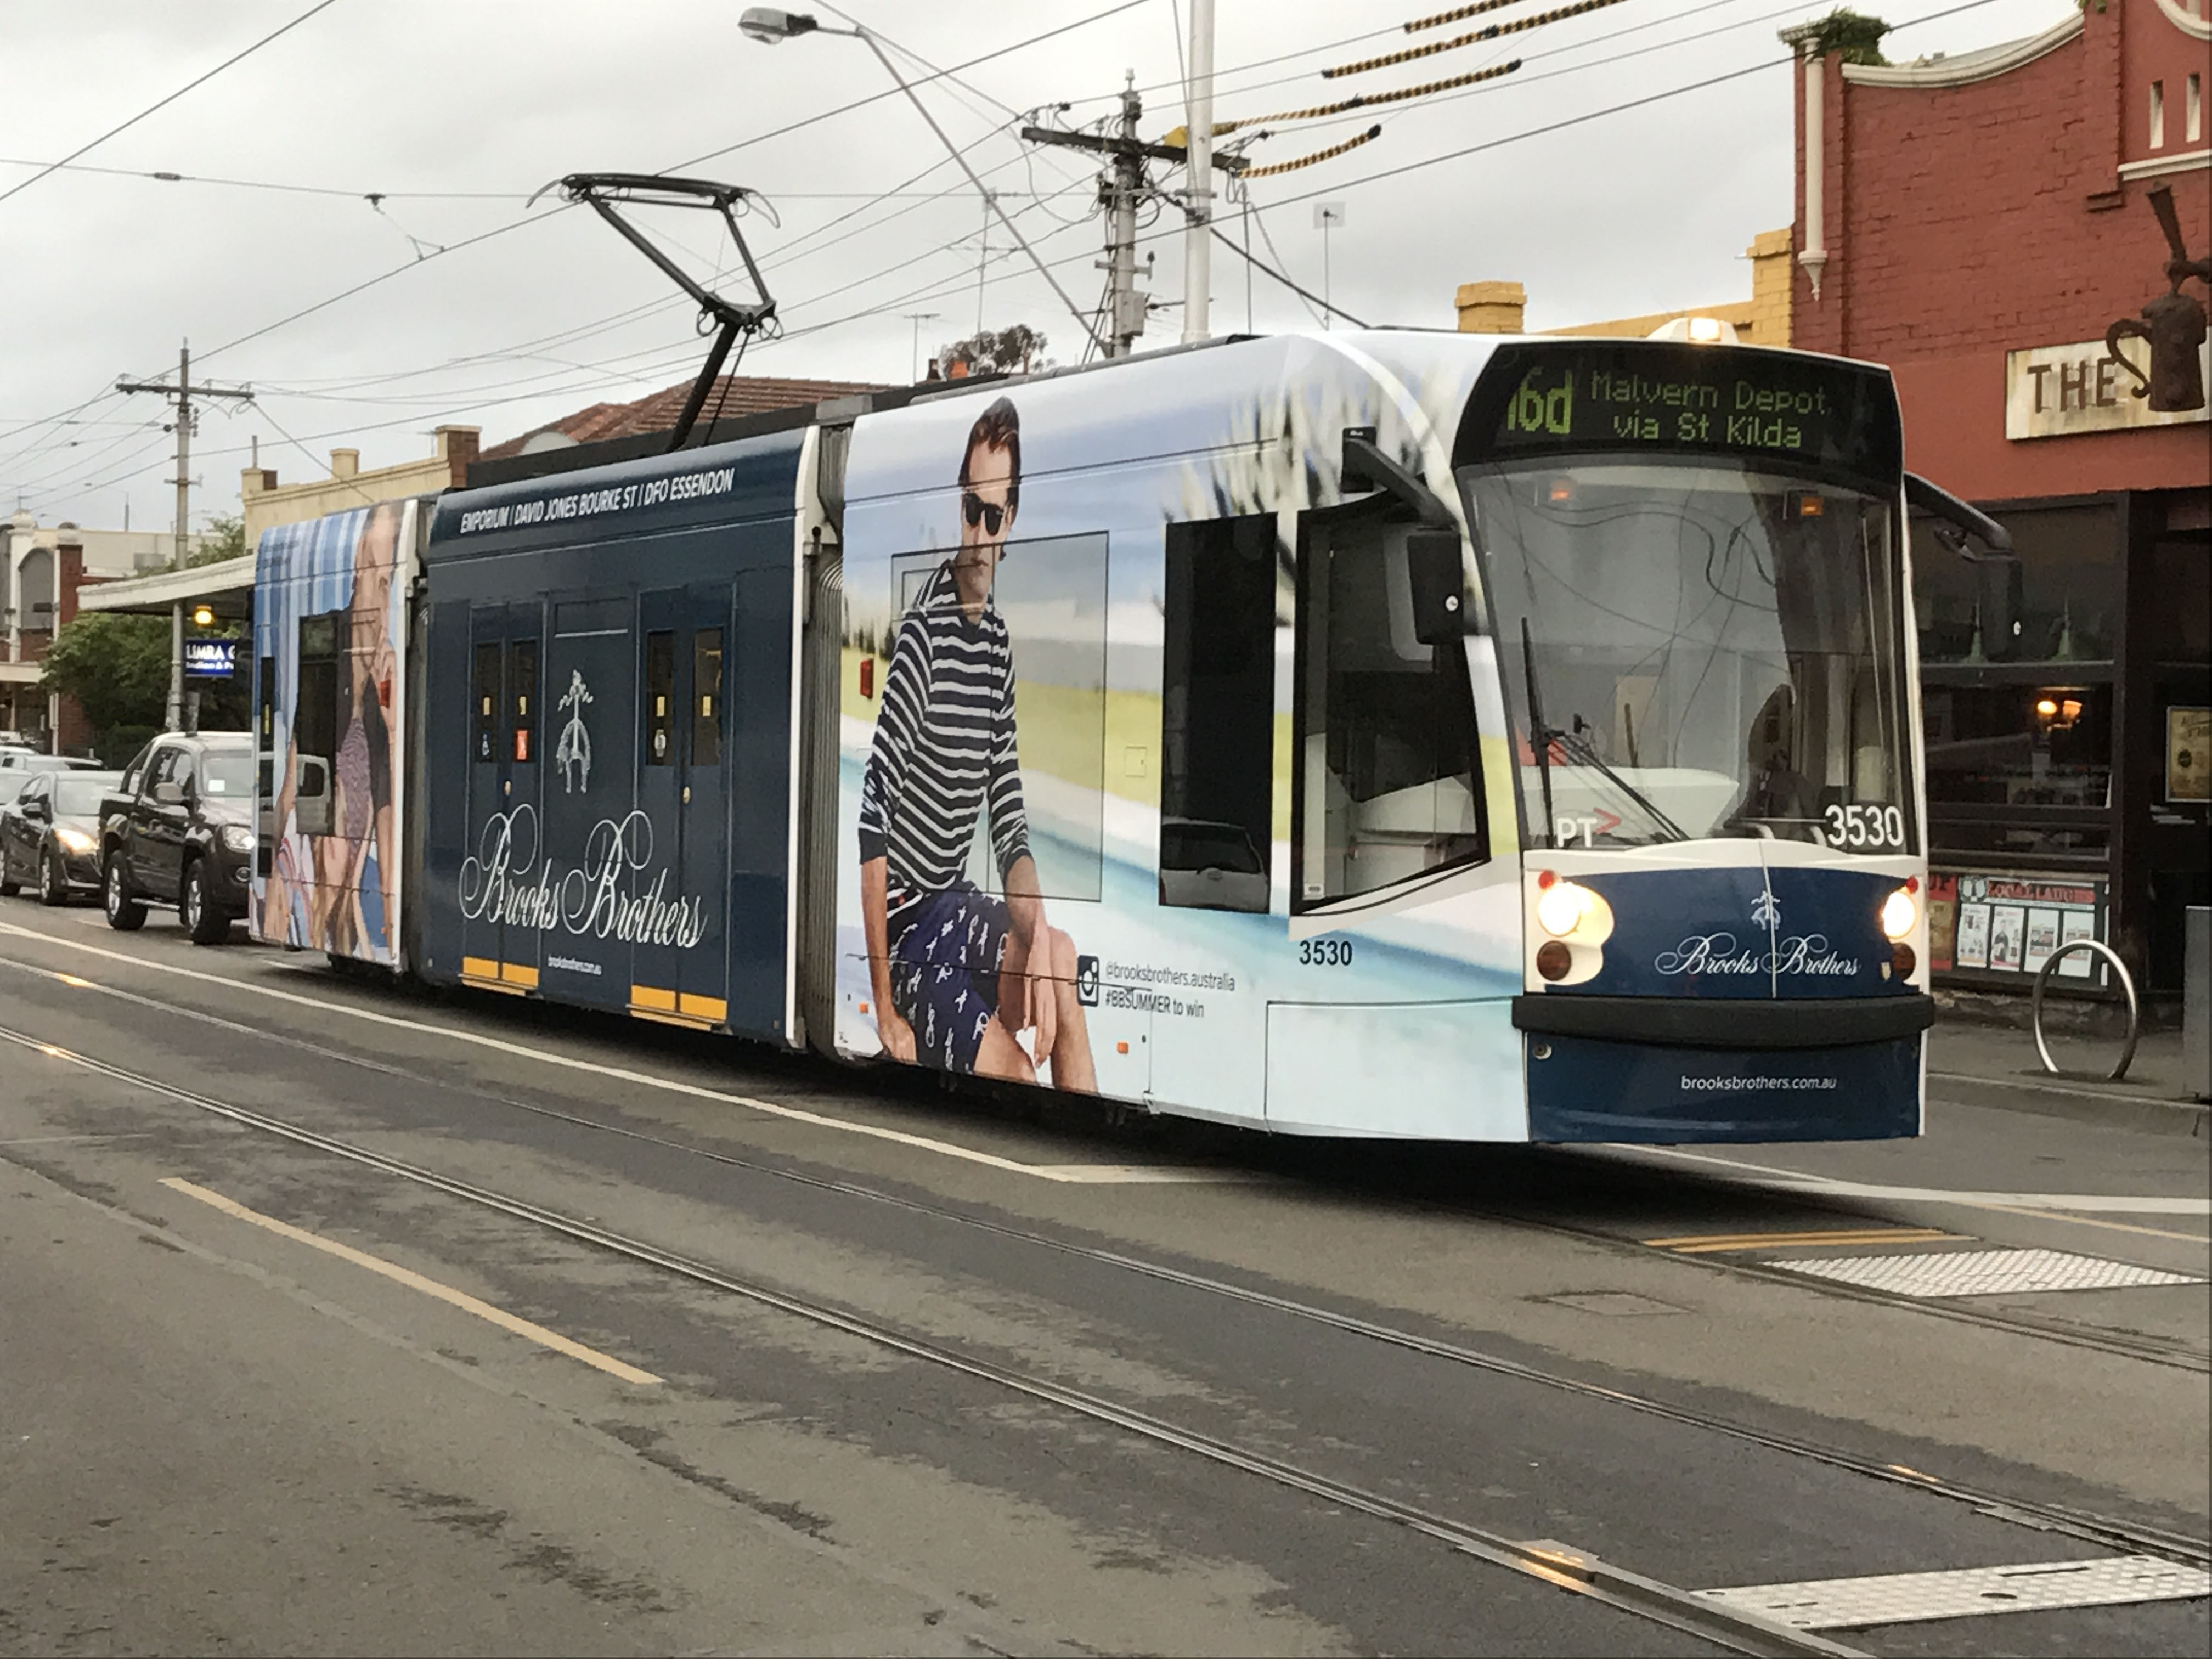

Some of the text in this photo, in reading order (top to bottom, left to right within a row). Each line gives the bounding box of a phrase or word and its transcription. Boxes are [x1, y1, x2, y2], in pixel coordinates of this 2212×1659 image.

[1592, 370, 1828, 415] Malvern Depot
[2027, 357, 2117, 414] THE
[1613, 409, 1801, 448] via St Kilda
[460, 506, 510, 534] EMPORIUM
[514, 500, 545, 525] DAVID
[544, 495, 579, 521] JONES
[578, 488, 622, 516] BOURKE
[622, 485, 638, 509] ST
[644, 478, 669, 506] DFO
[669, 467, 735, 501] ESSENDON
[1825, 805, 1903, 847] 3530
[459, 804, 708, 948] Brooks Brothers
[1299, 939, 1353, 966] 3530
[1655, 932, 1860, 976] Brooks Brothers
[1105, 961, 1235, 991] @brooksbrothers.australia
[1105, 989, 1205, 1018] #BBSUMMER to win
[1681, 1075, 1837, 1091] brooksbrothers.com.au
